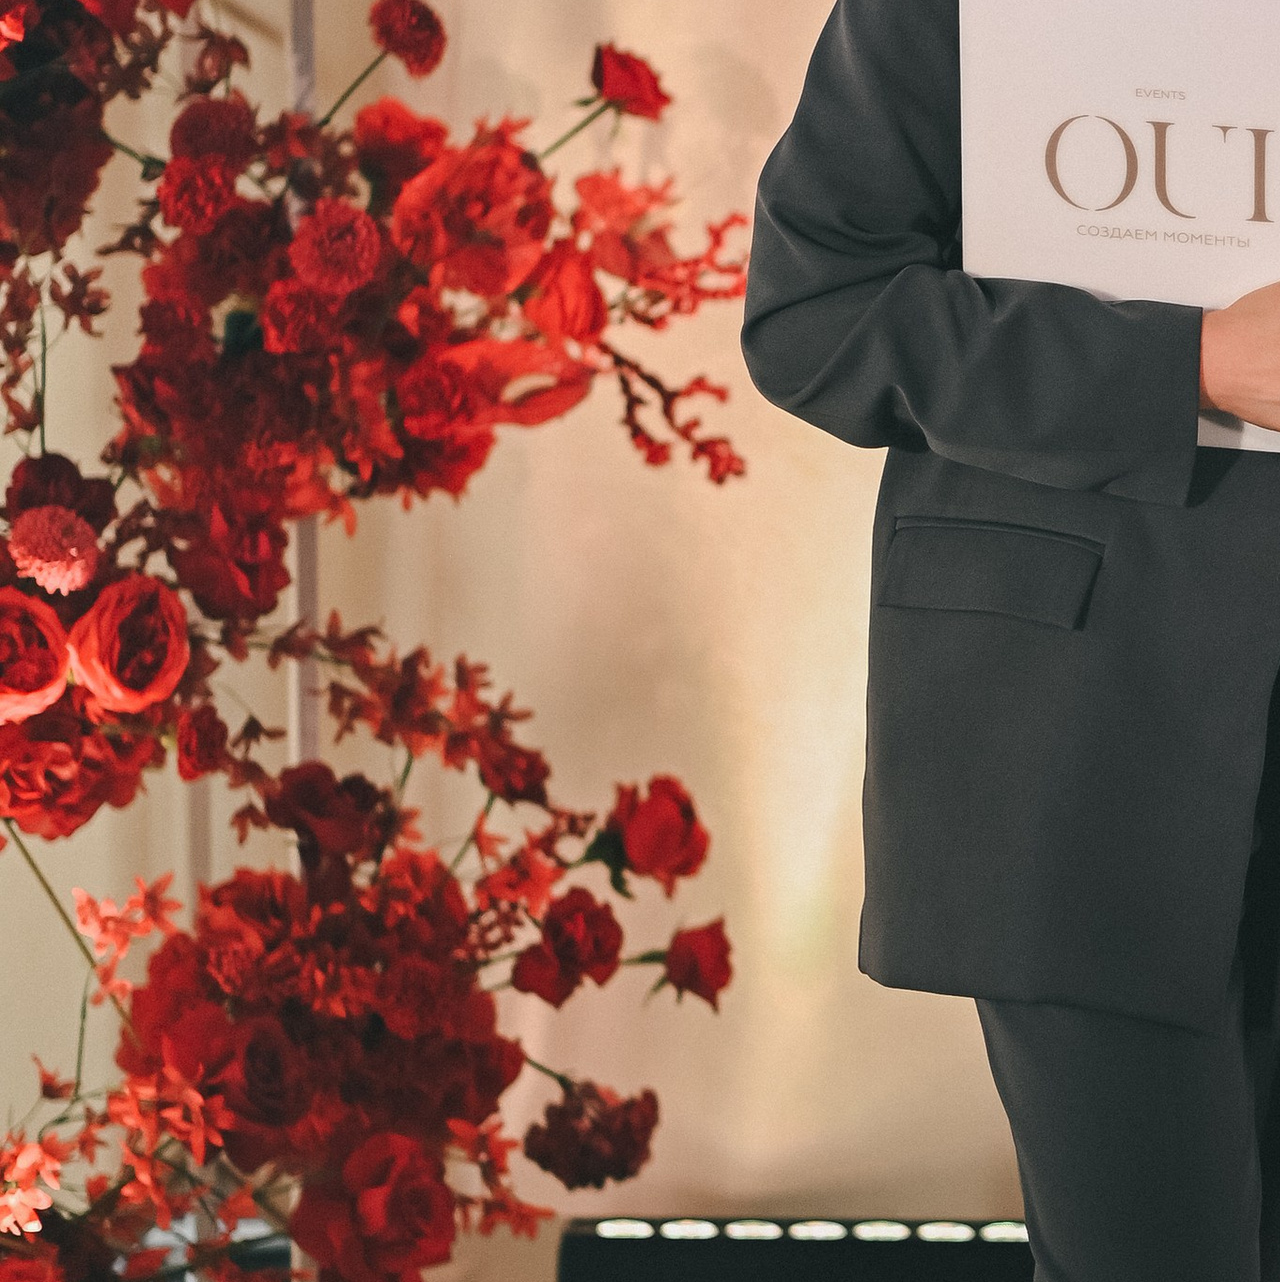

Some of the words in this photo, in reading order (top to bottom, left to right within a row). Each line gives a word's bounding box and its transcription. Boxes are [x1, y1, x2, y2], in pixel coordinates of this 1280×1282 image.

[1135, 88, 1186, 101] EVENTS
[1045, 115, 1275, 223] OUI
[1076, 224, 1158, 242] СОЗДАЕМ
[1162, 231, 1251, 248] МОМЕНТЫ
